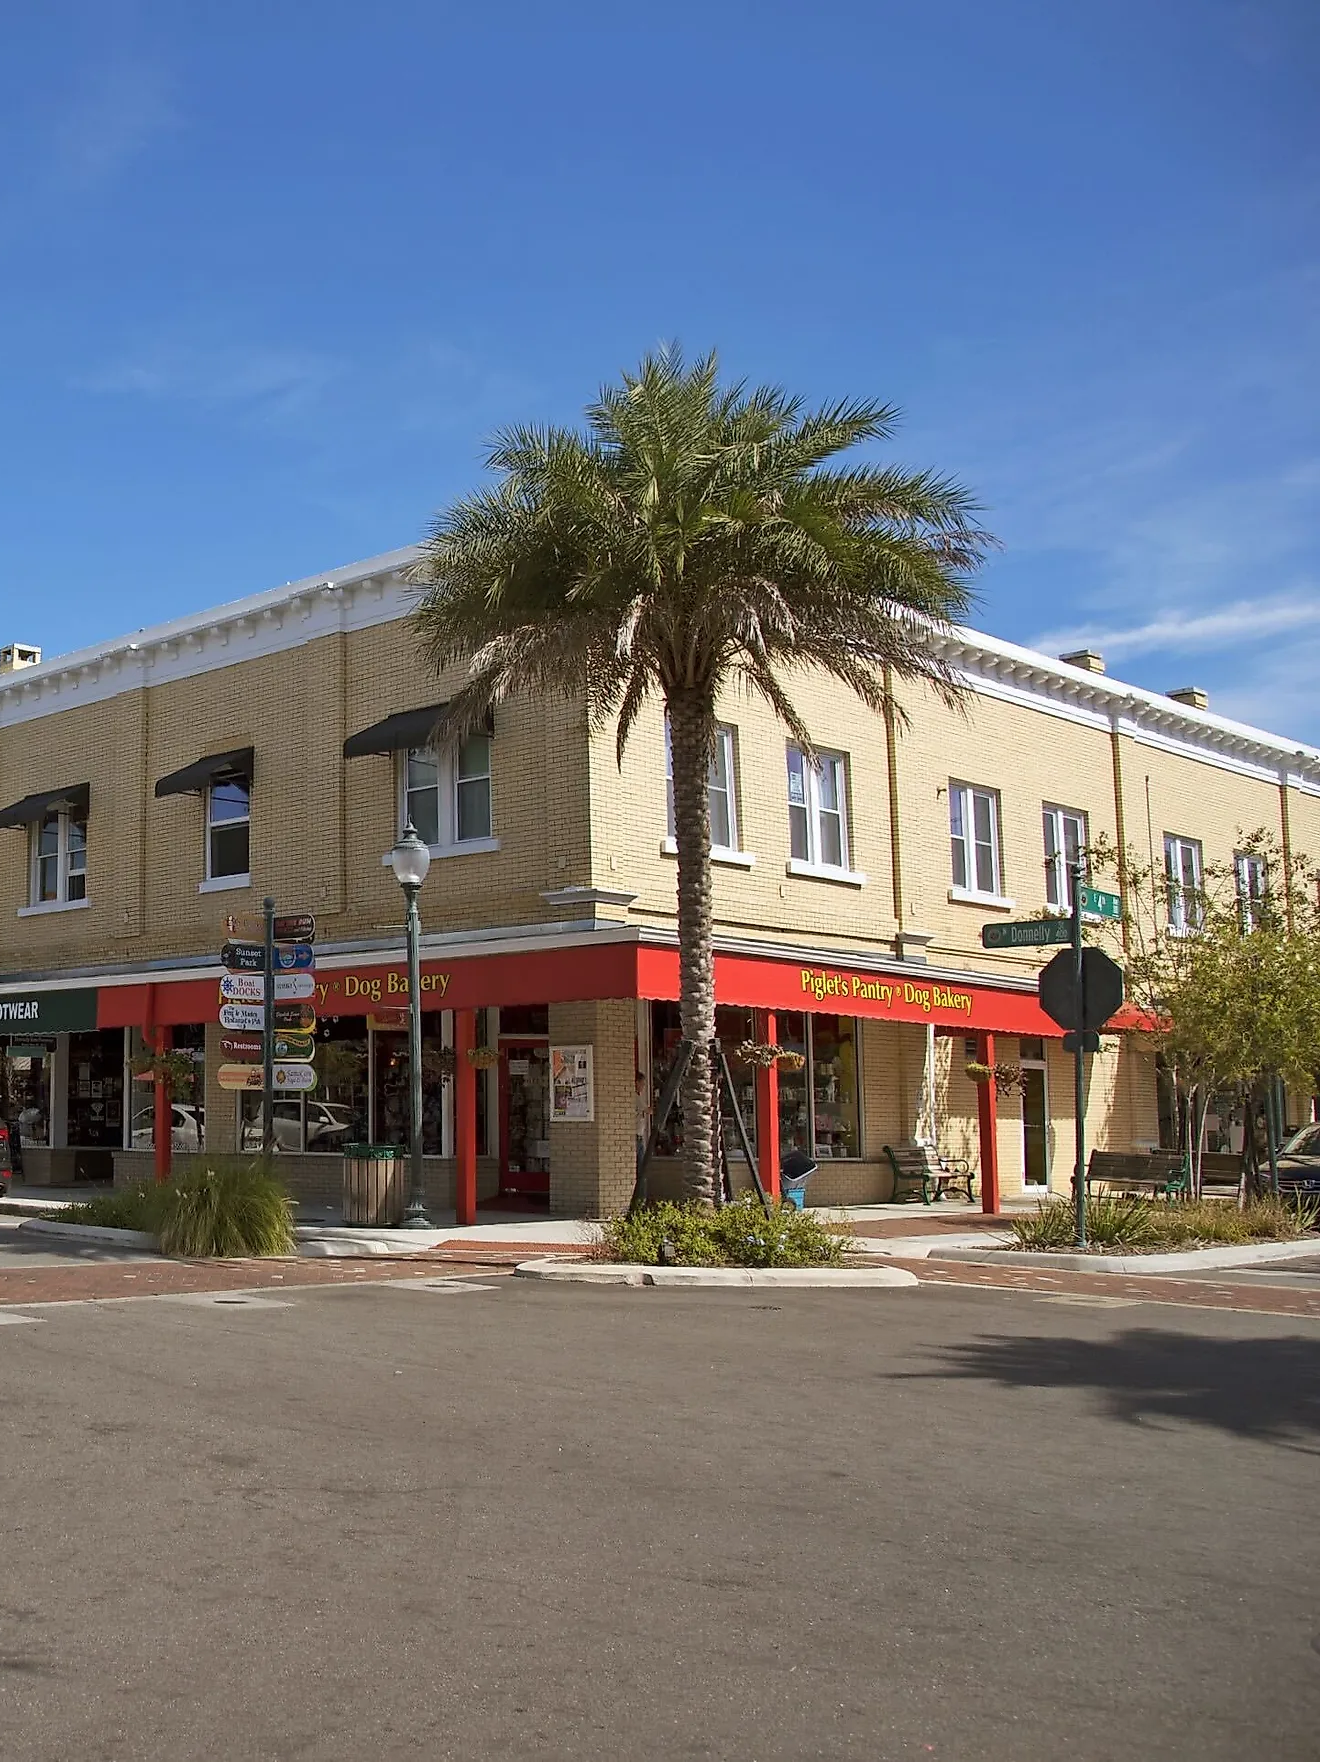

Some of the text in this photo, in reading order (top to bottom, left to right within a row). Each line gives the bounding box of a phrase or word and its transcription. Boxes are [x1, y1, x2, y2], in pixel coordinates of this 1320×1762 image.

[1011, 925, 1050, 943] Donnelly
[235, 947, 262, 957] Sunset
[240, 958, 257, 967] Park
[232, 986, 261, 996] DOCKS
[344, 976, 382, 1002] Dog
[387, 972, 450, 998] Baery
[801, 969, 973, 1017] Piglet's Pantry Dog Bakery
[234, 1042, 262, 1051] Restrooms
